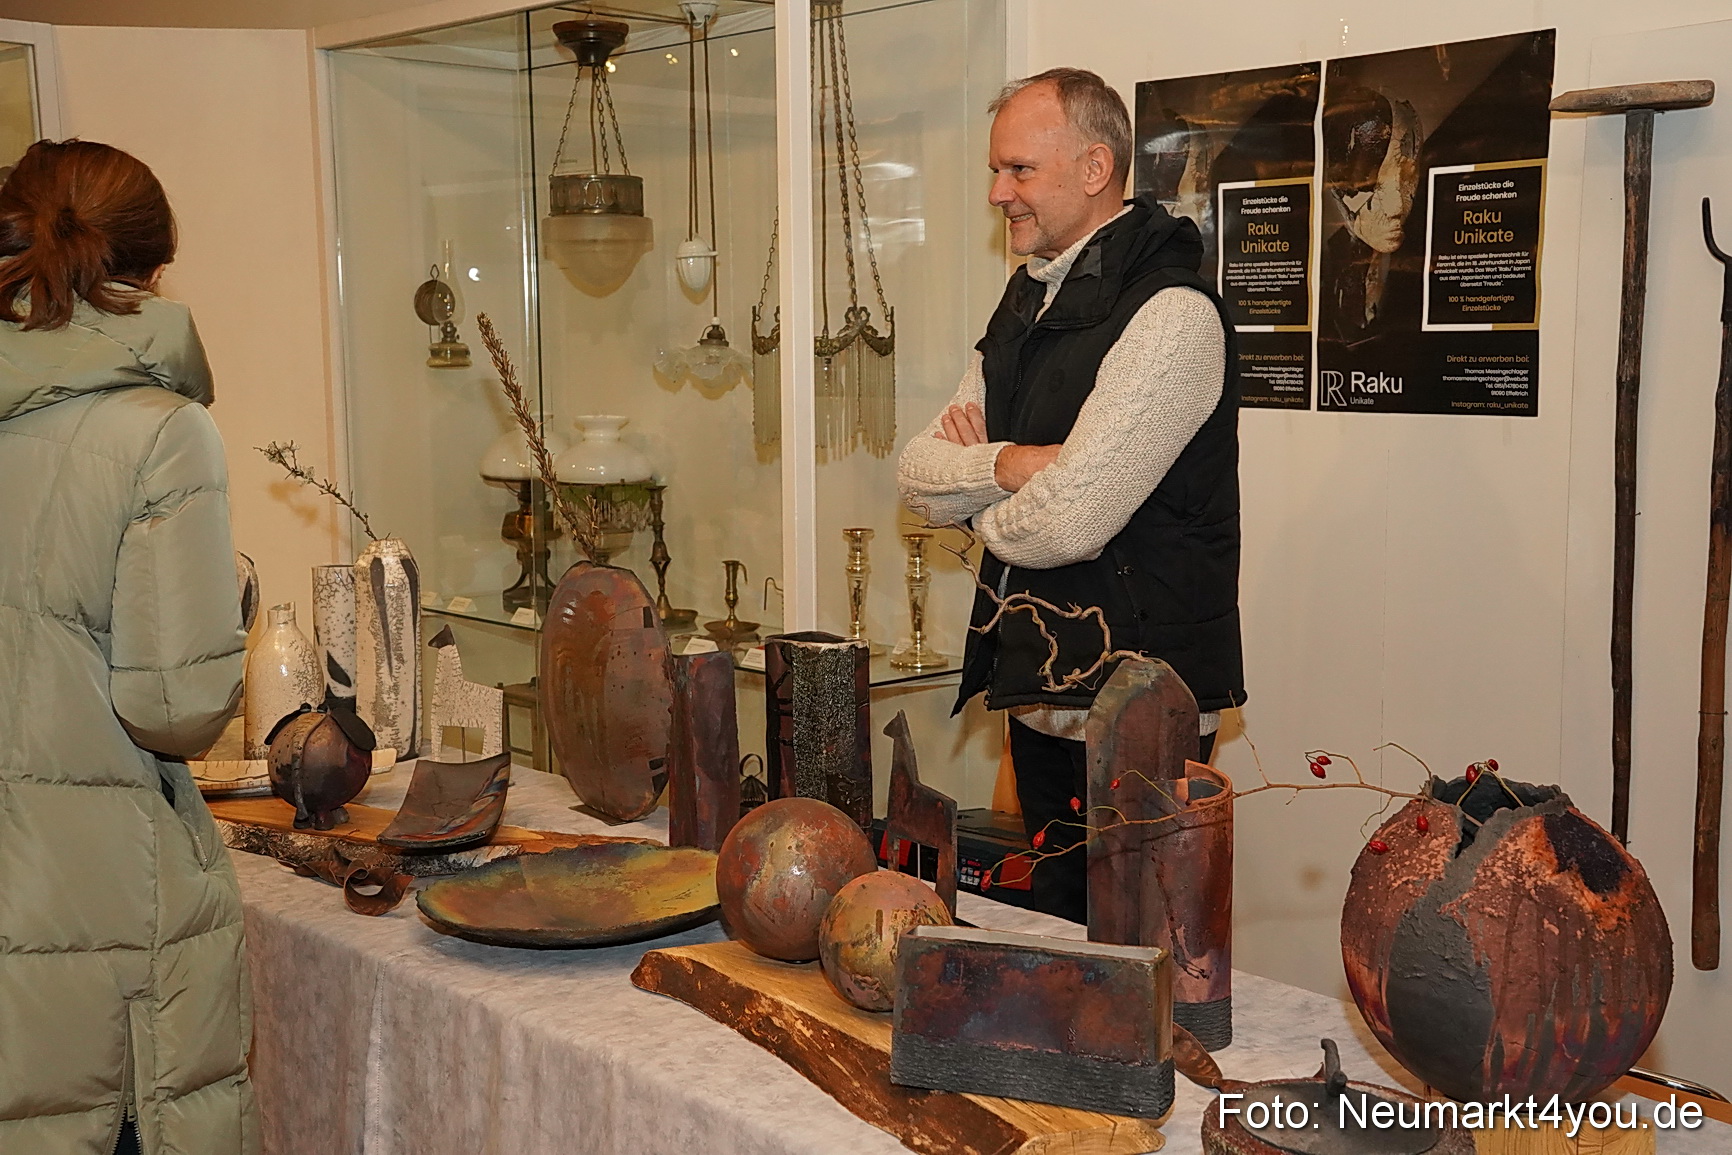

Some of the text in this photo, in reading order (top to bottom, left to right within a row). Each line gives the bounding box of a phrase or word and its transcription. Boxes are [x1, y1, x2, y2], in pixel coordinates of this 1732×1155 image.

[1459, 180, 1514, 191] Einzelstücke die
[1243, 196, 1277, 205] Einzelstücke
[1482, 192, 1517, 200] schenken
[1464, 209, 1501, 225] Raku
[1248, 222, 1279, 235] Raku
[1454, 229, 1514, 244] Unikate
[1241, 239, 1289, 253] Unikate
[1466, 295, 1514, 303] handgefertigte
[1351, 372, 1402, 393] Raku
[1350, 397, 1374, 405] Unikate
[1451, 401, 1485, 409] Instagram:
